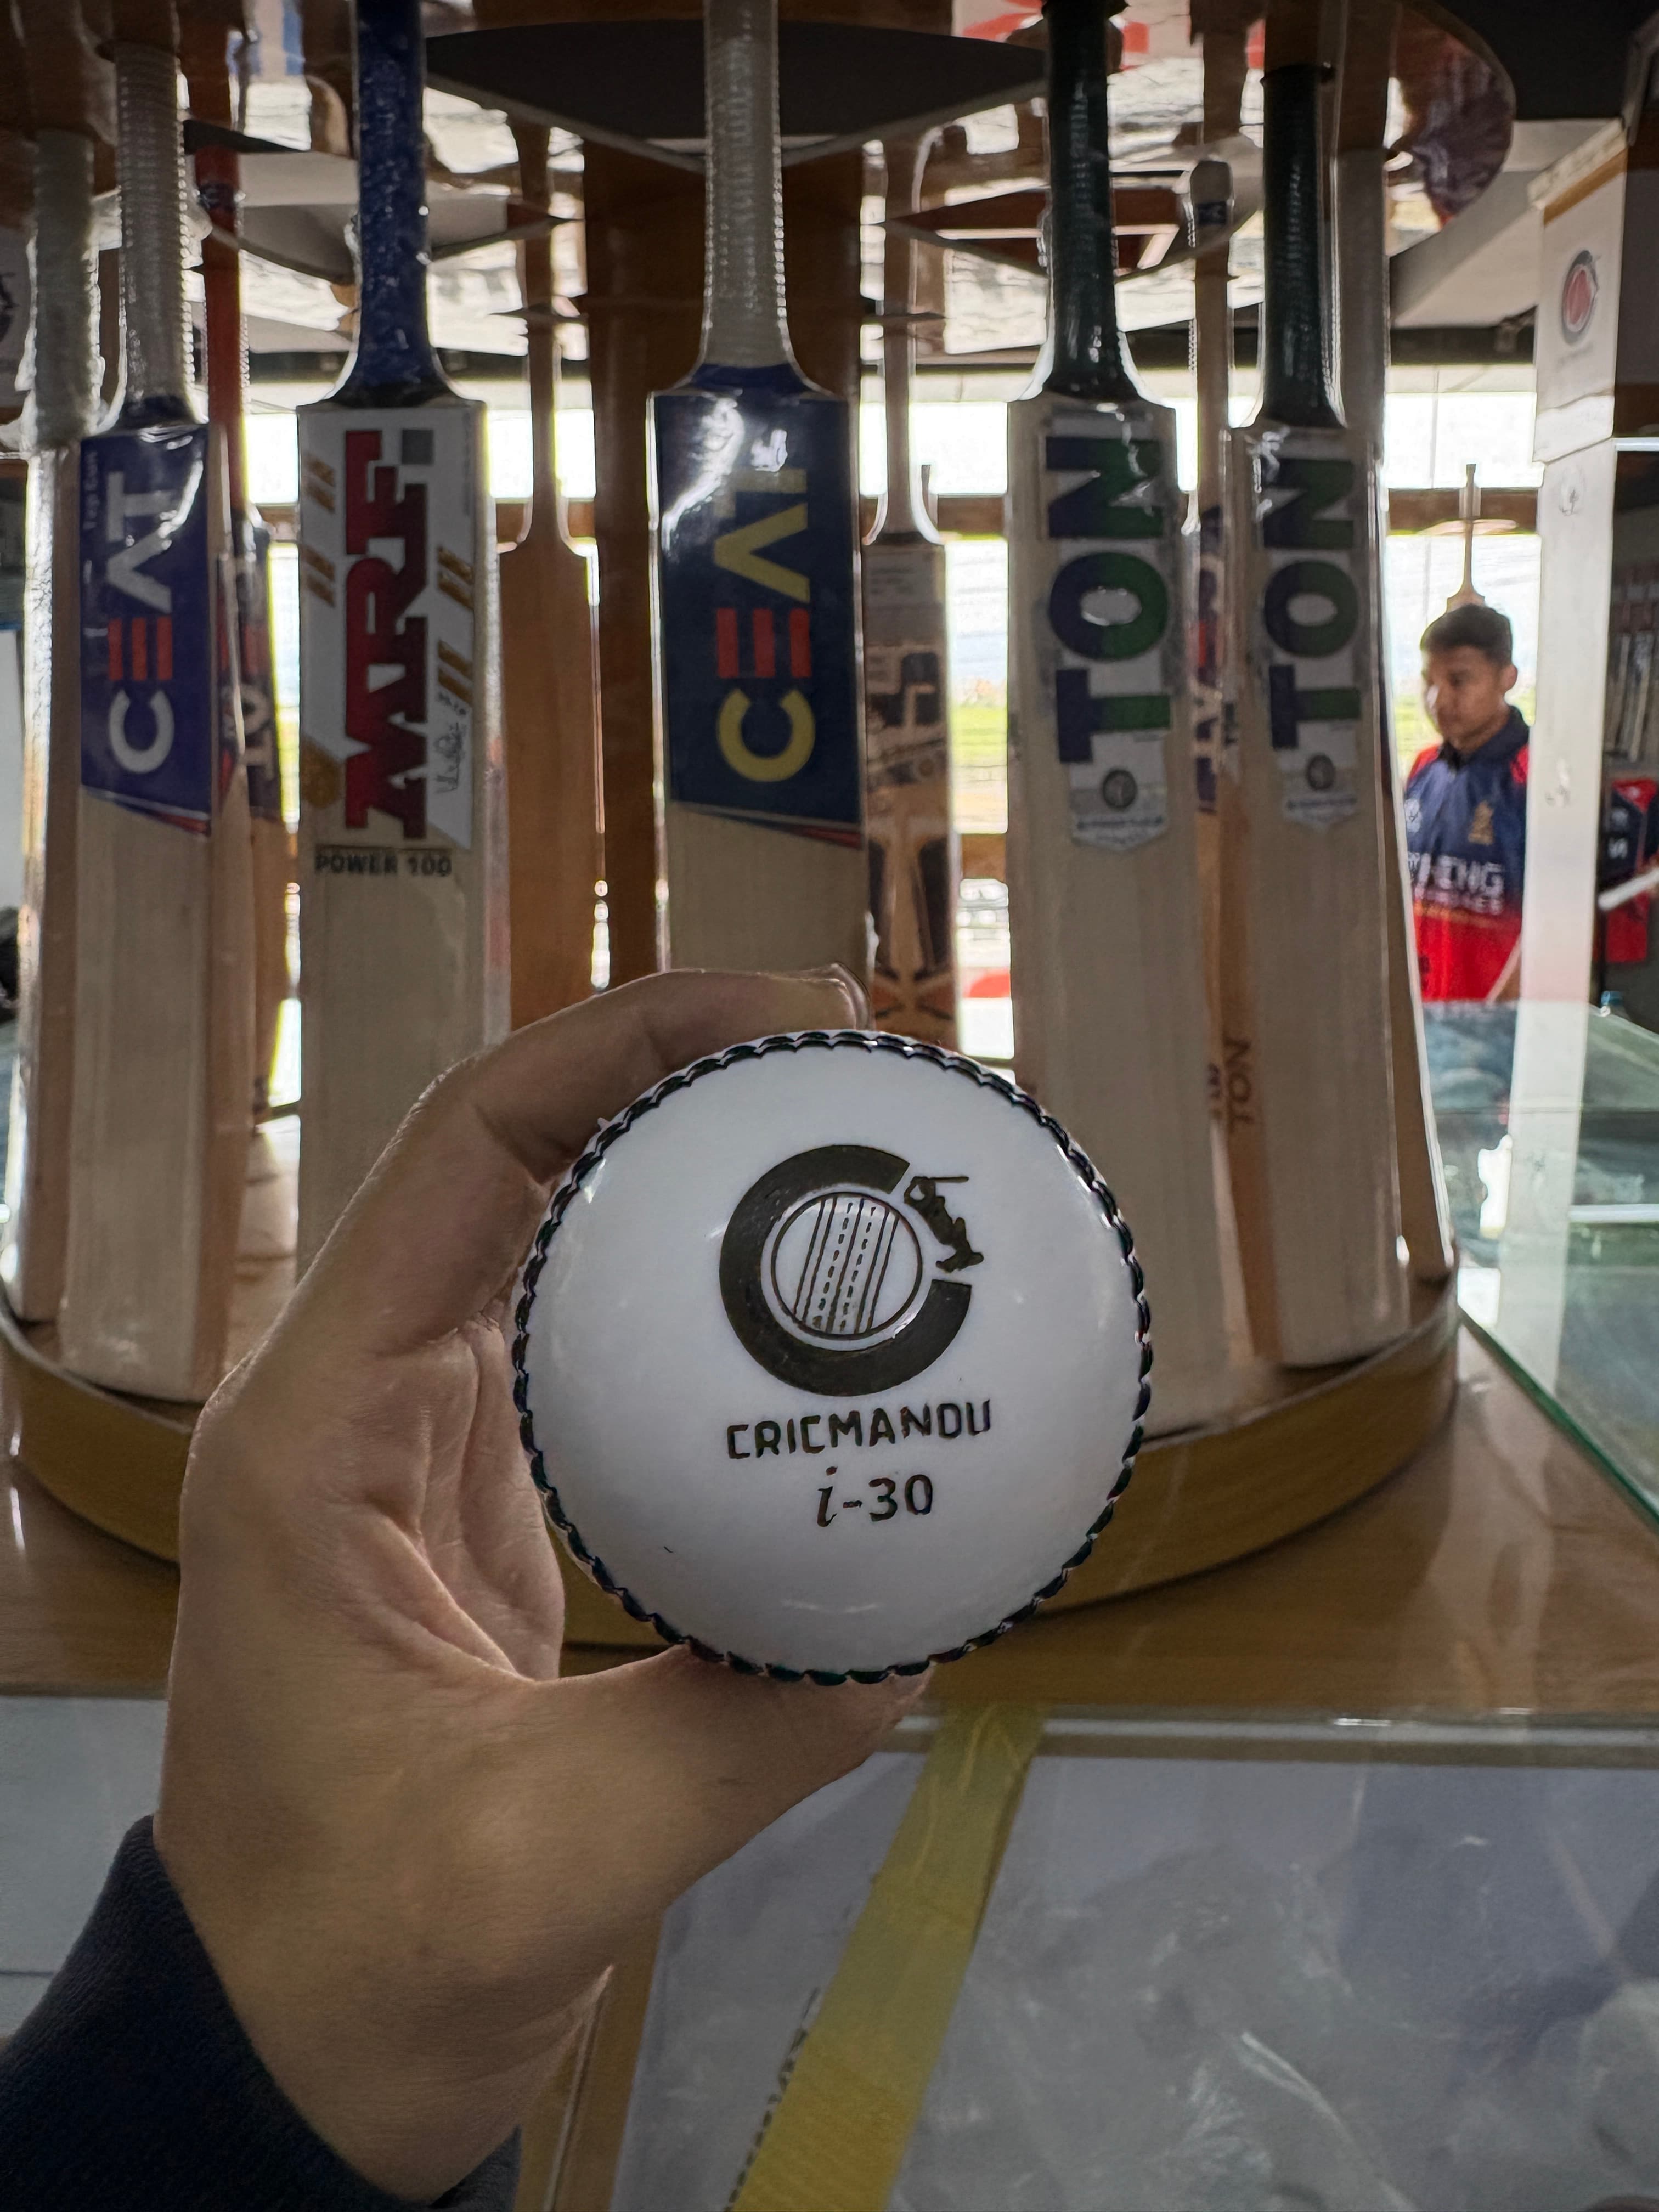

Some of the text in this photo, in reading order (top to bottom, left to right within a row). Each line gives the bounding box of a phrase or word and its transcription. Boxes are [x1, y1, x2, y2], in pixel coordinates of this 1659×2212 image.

[106, 471, 175, 774] CEAT
[346, 430, 428, 839] MRF
[713, 464, 816, 782] CEAT
[1045, 436, 1171, 764] TON
[1260, 458, 1362, 751] TON
[314, 853, 453, 877] POWER 100
[726, 1399, 991, 1459] CRICMANDU
[817, 1466, 934, 1527] i-30
